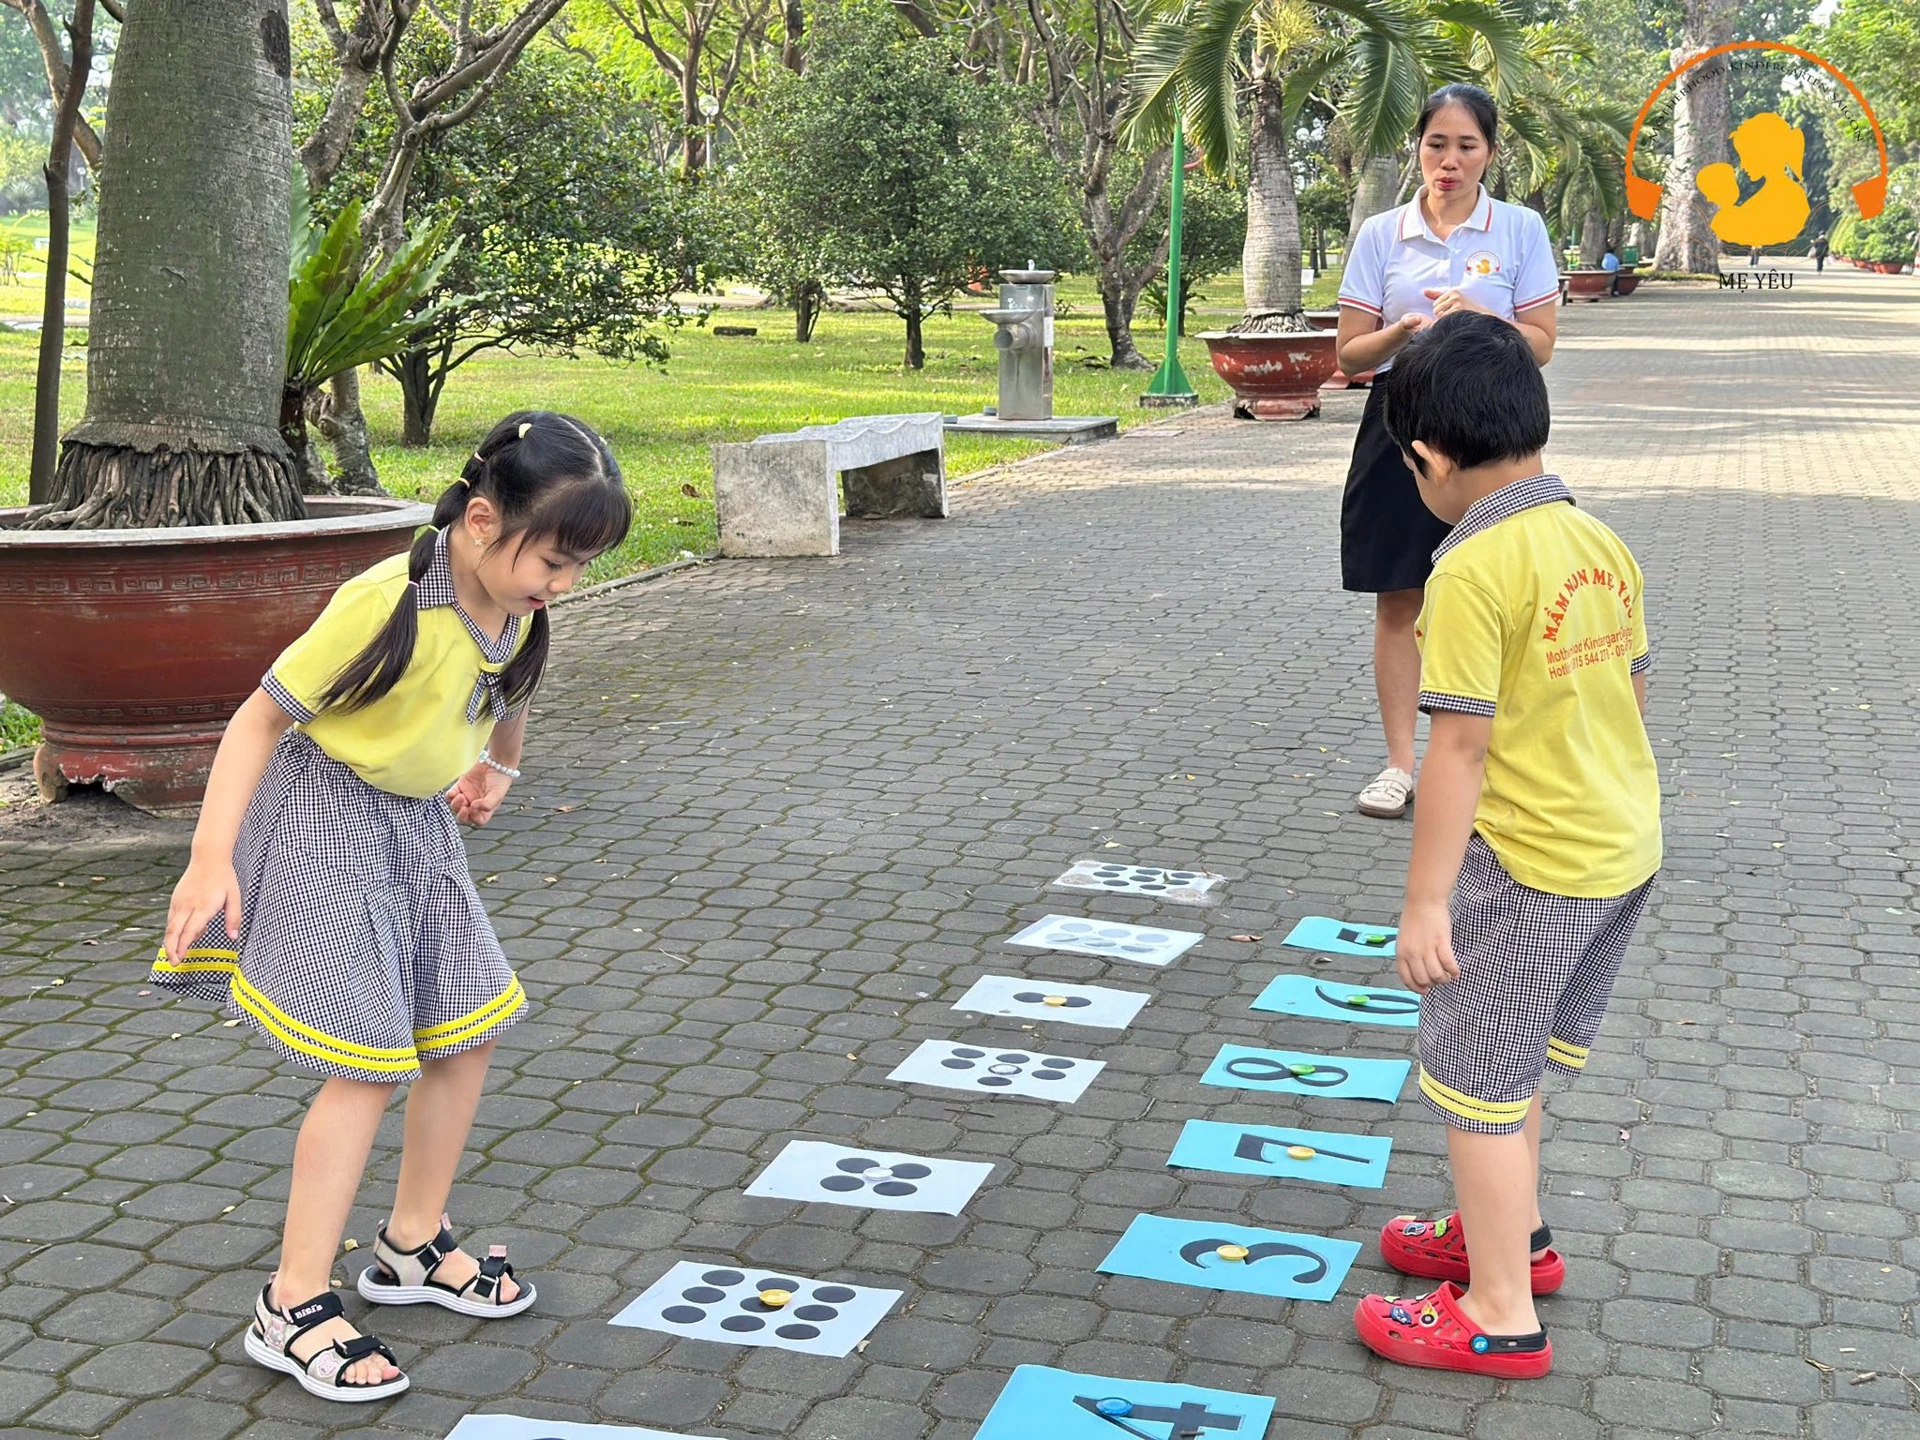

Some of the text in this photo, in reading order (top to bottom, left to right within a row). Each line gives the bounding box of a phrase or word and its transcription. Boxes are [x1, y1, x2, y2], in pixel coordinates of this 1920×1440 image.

[1592, 568, 1614, 591] MẸ
[1584, 651, 1599, 666] 544
[1225, 1056, 1349, 1088] 8
[1233, 1132, 1371, 1164] 7
[1180, 1238, 1329, 1284] 3
[1072, 1395, 1245, 1440] 4
